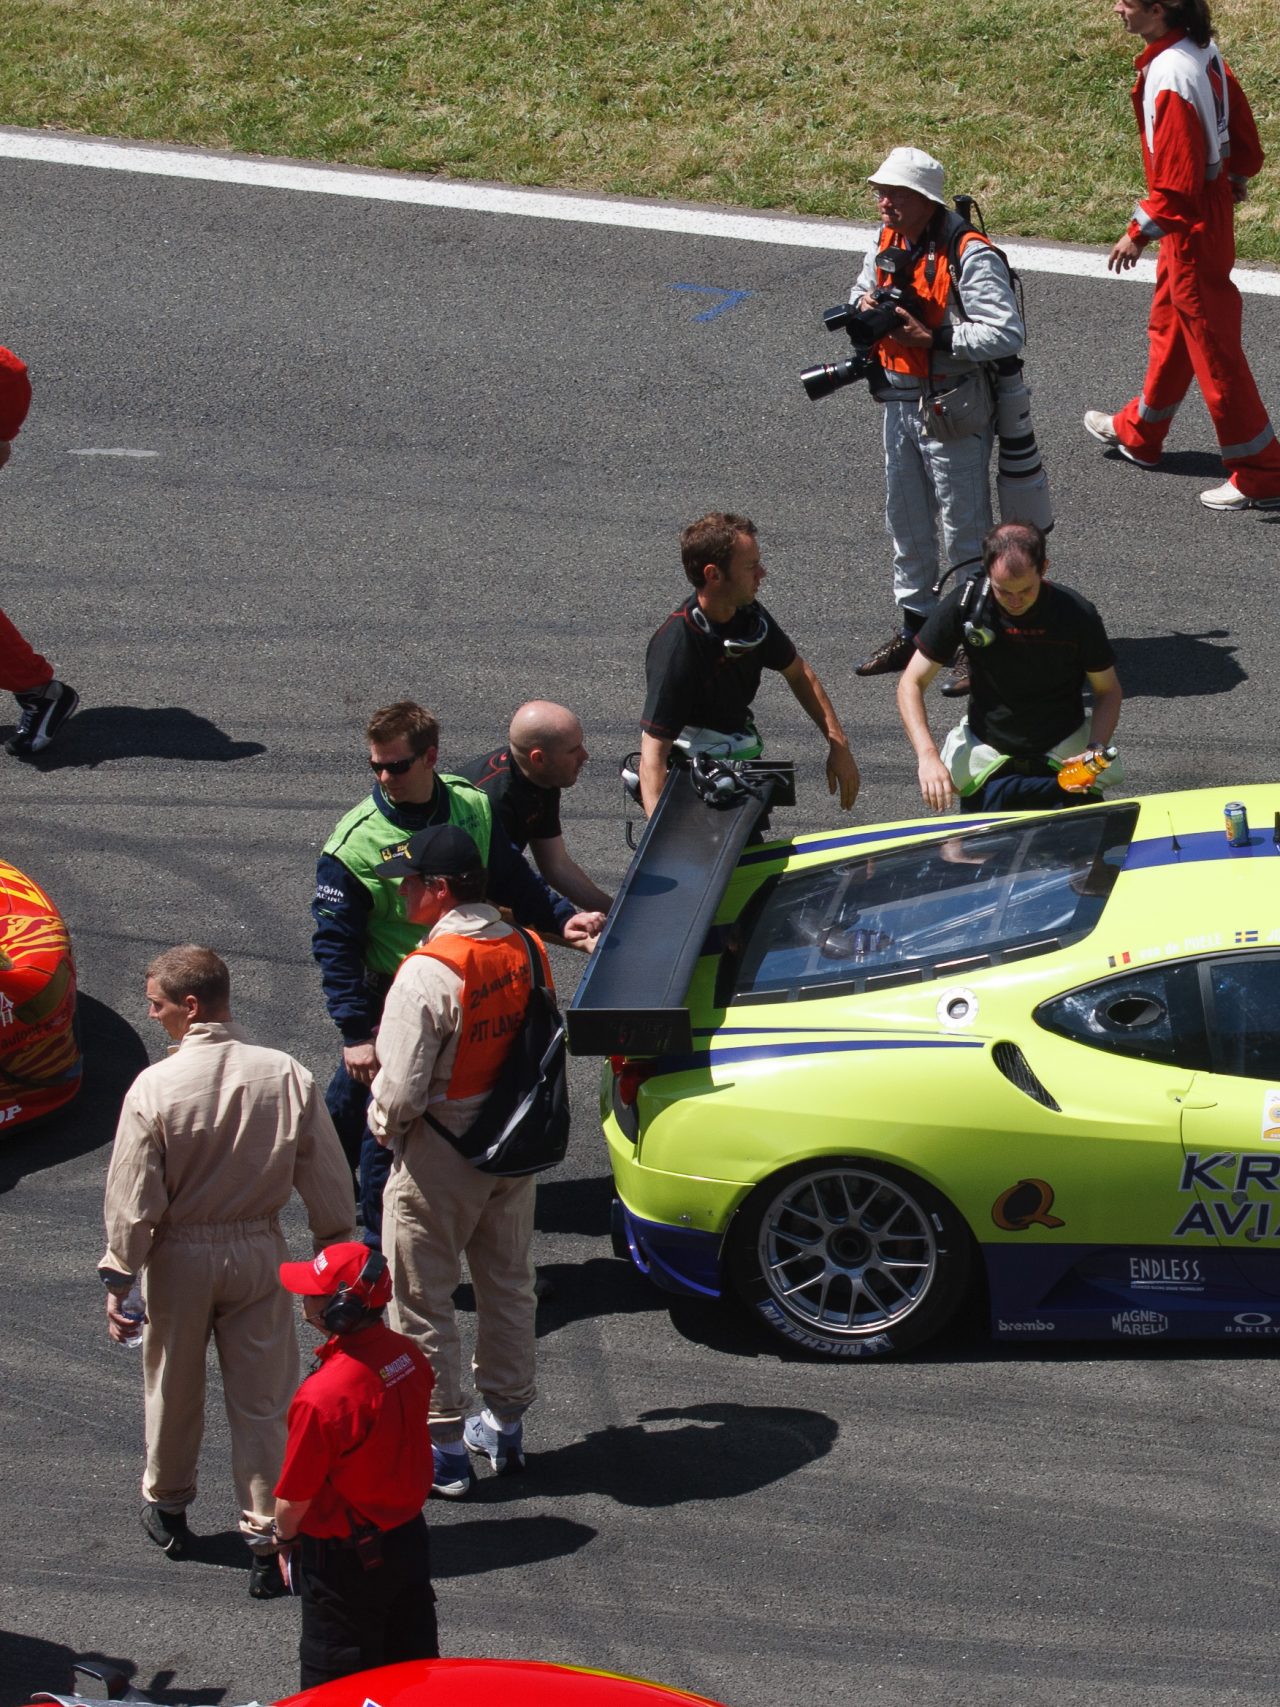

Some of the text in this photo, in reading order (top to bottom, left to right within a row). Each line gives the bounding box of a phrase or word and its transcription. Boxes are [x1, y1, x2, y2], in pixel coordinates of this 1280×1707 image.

[1129, 1257, 1200, 1281] ENDLESS
[761, 1303, 862, 1356] MICHELIN
[998, 1319, 1056, 1332] brembo
[1224, 1326, 1280, 1334] OAKLEY
